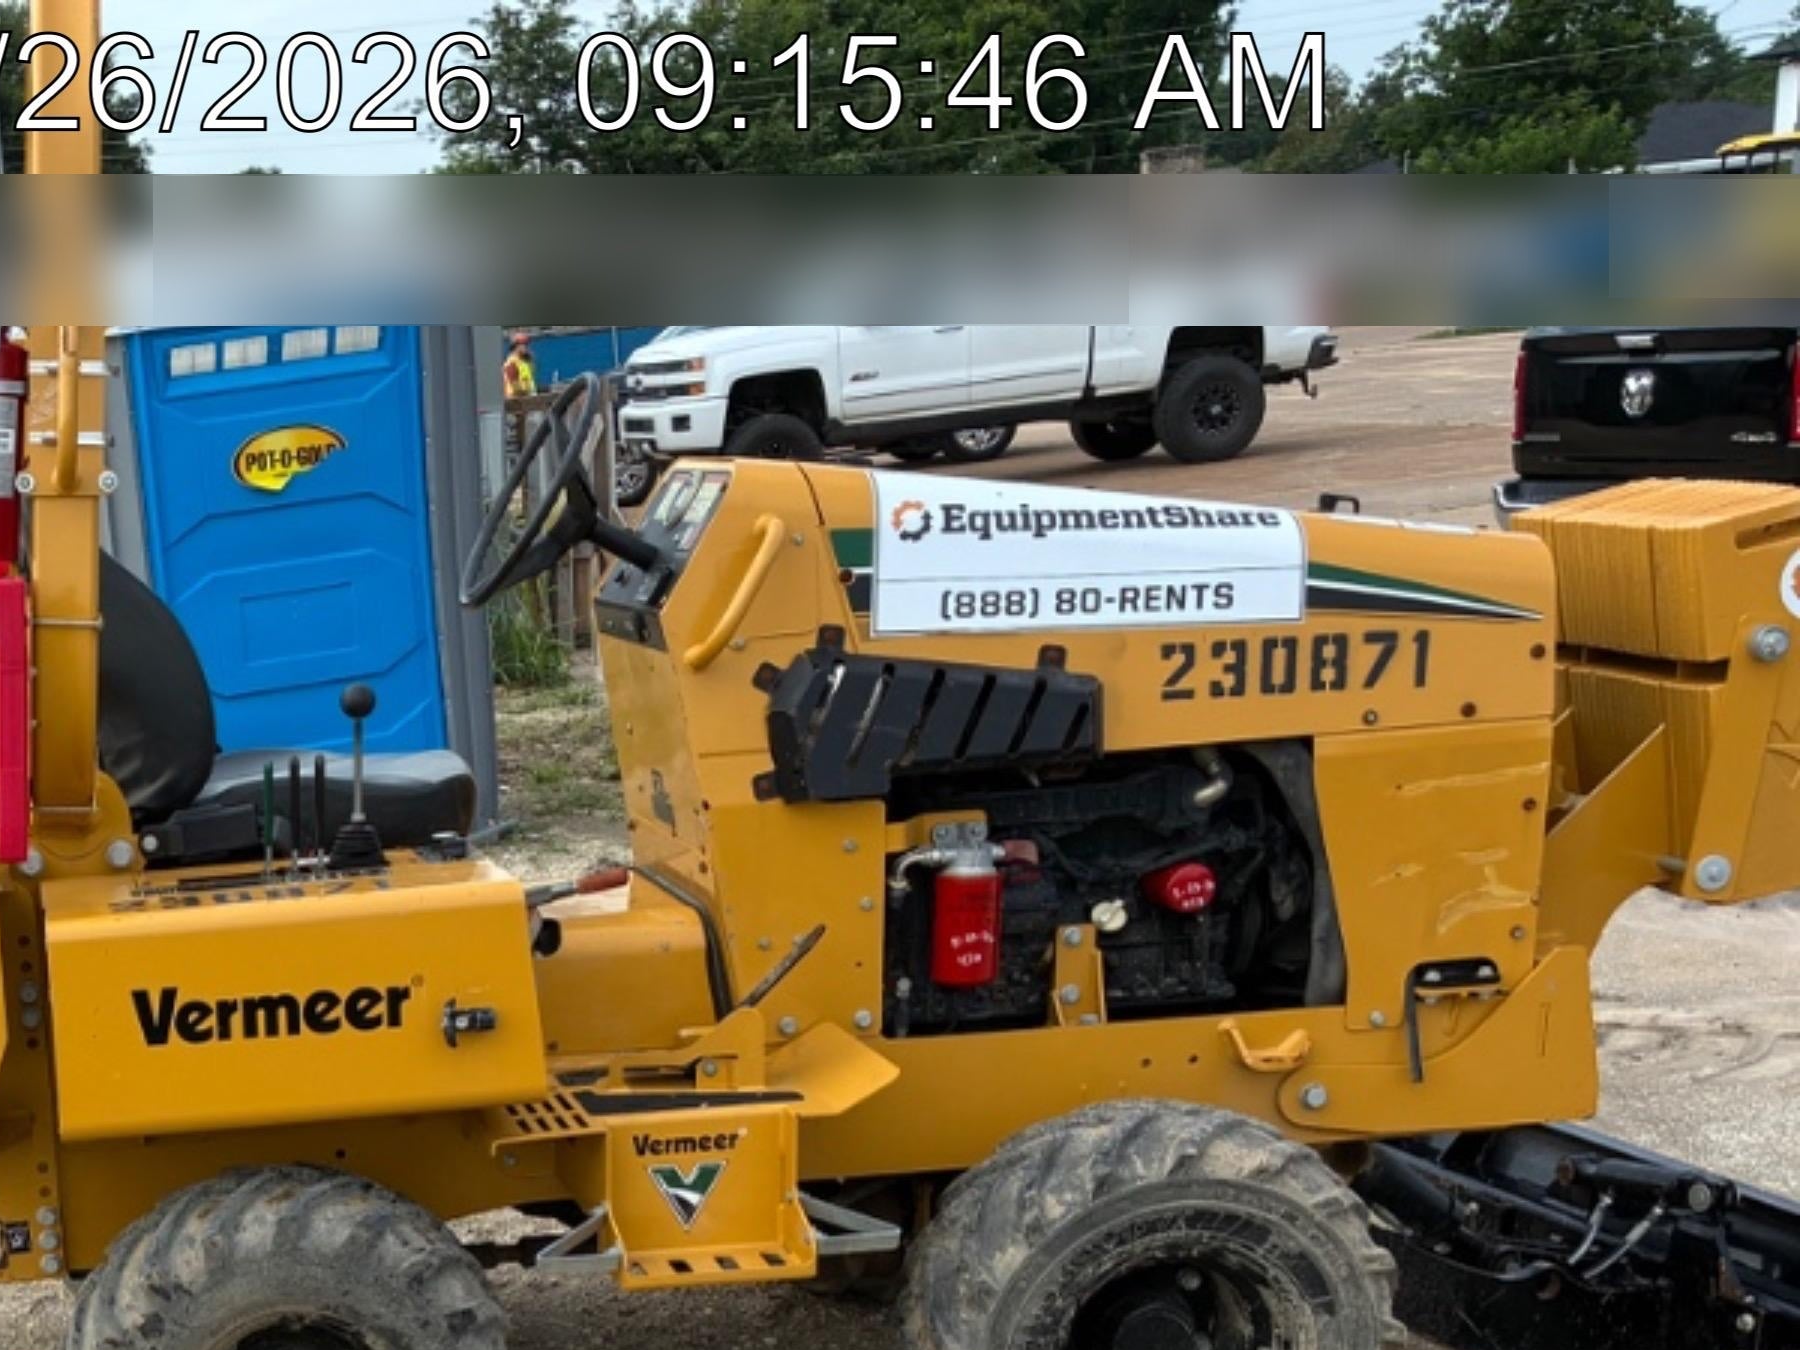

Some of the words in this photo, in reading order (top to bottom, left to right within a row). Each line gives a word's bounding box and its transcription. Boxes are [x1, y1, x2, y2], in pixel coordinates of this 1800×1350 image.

[939, 502, 1282, 540] EquipmentShare
[940, 587, 1040, 620] (888)
[1055, 581, 1236, 617] 80-RENTS
[1159, 629, 1431, 701] 230871
[130, 985, 413, 1049] Vermeer
[631, 1132, 740, 1157] Vermeer
